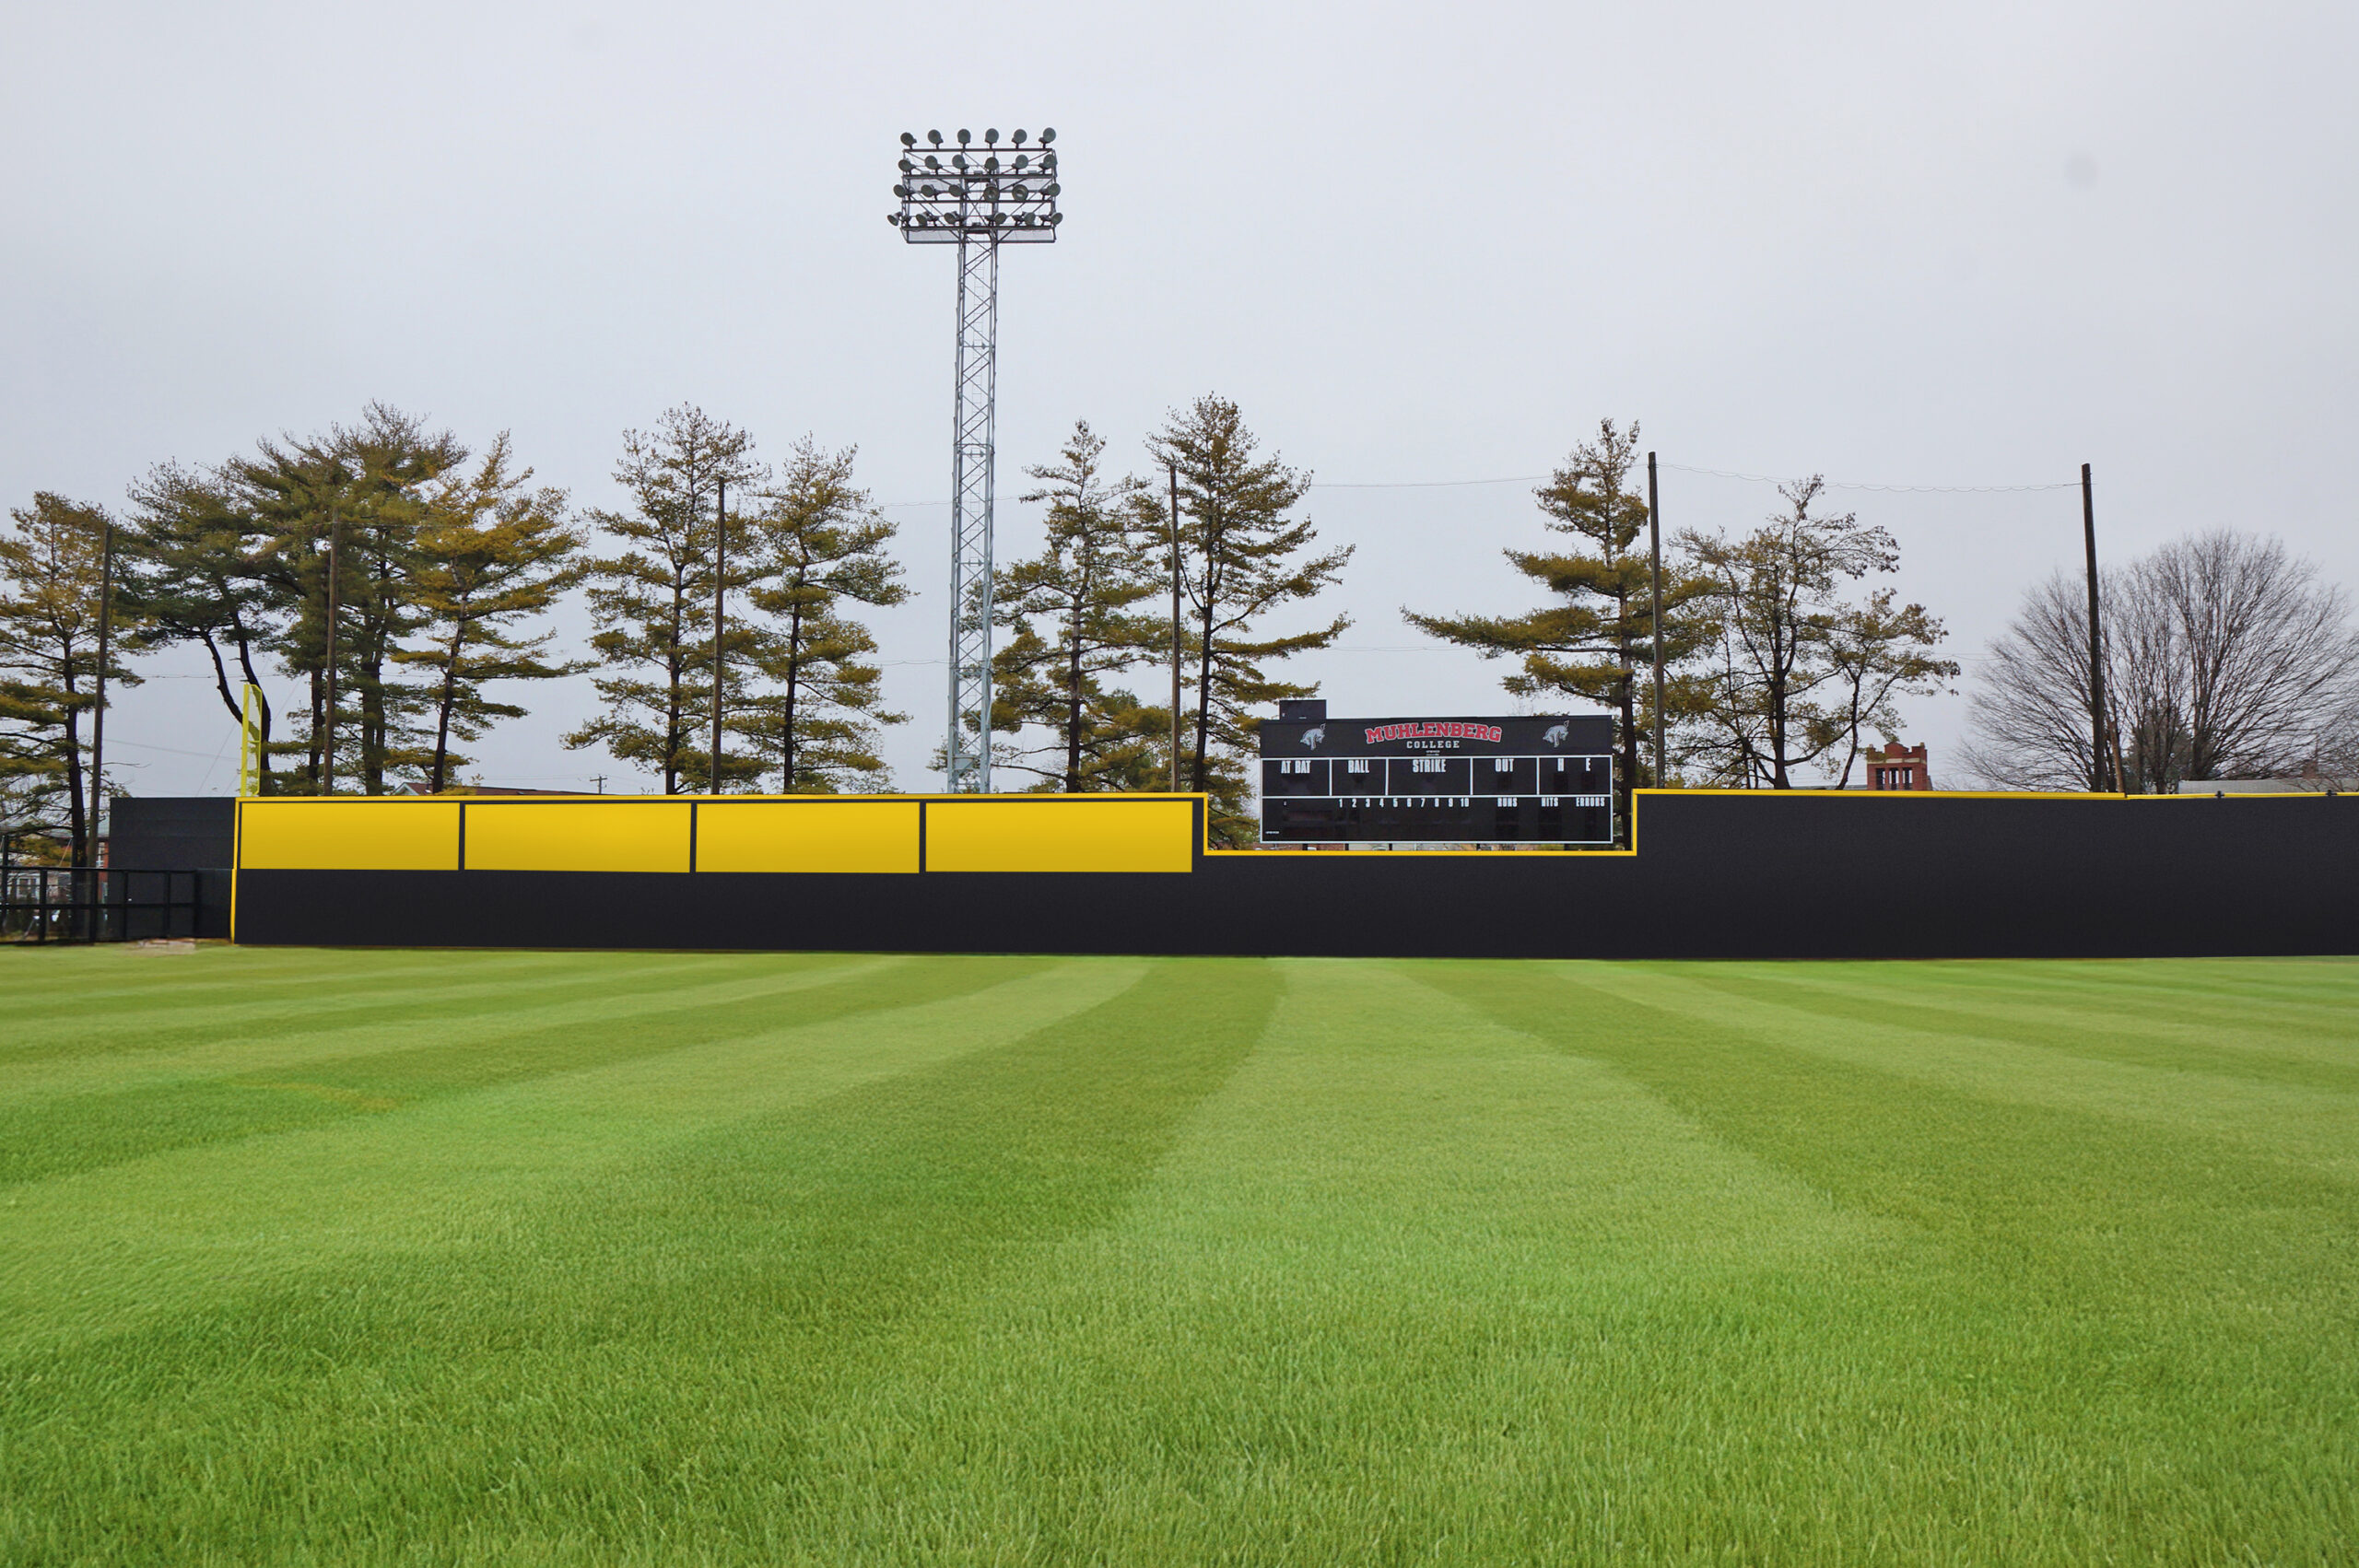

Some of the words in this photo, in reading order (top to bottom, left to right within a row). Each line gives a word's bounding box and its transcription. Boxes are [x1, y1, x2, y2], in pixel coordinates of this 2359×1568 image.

[1364, 721, 1503, 744] MUHLENBERG
[1406, 740, 1461, 749] COLLEGE
[1280, 760, 1291, 774] AT
[1295, 760, 1311, 774] BAT
[1347, 759, 1370, 774] BALL
[1412, 759, 1447, 773] STRIKE
[1495, 758, 1514, 772] OUT
[1557, 757, 1565, 772] H
[1585, 757, 1591, 772] E
[1338, 798, 1343, 808] 1
[1351, 798, 1357, 808] 2
[1365, 798, 1370, 808] 3
[1379, 798, 1384, 808] 4
[1392, 798, 1398, 808] 5
[1420, 798, 1426, 808] 7
[1461, 798, 1470, 808] 10
[1497, 797, 1518, 807] RUNS
[1541, 797, 1559, 807] HITS
[1576, 797, 1605, 807] ERRORS
